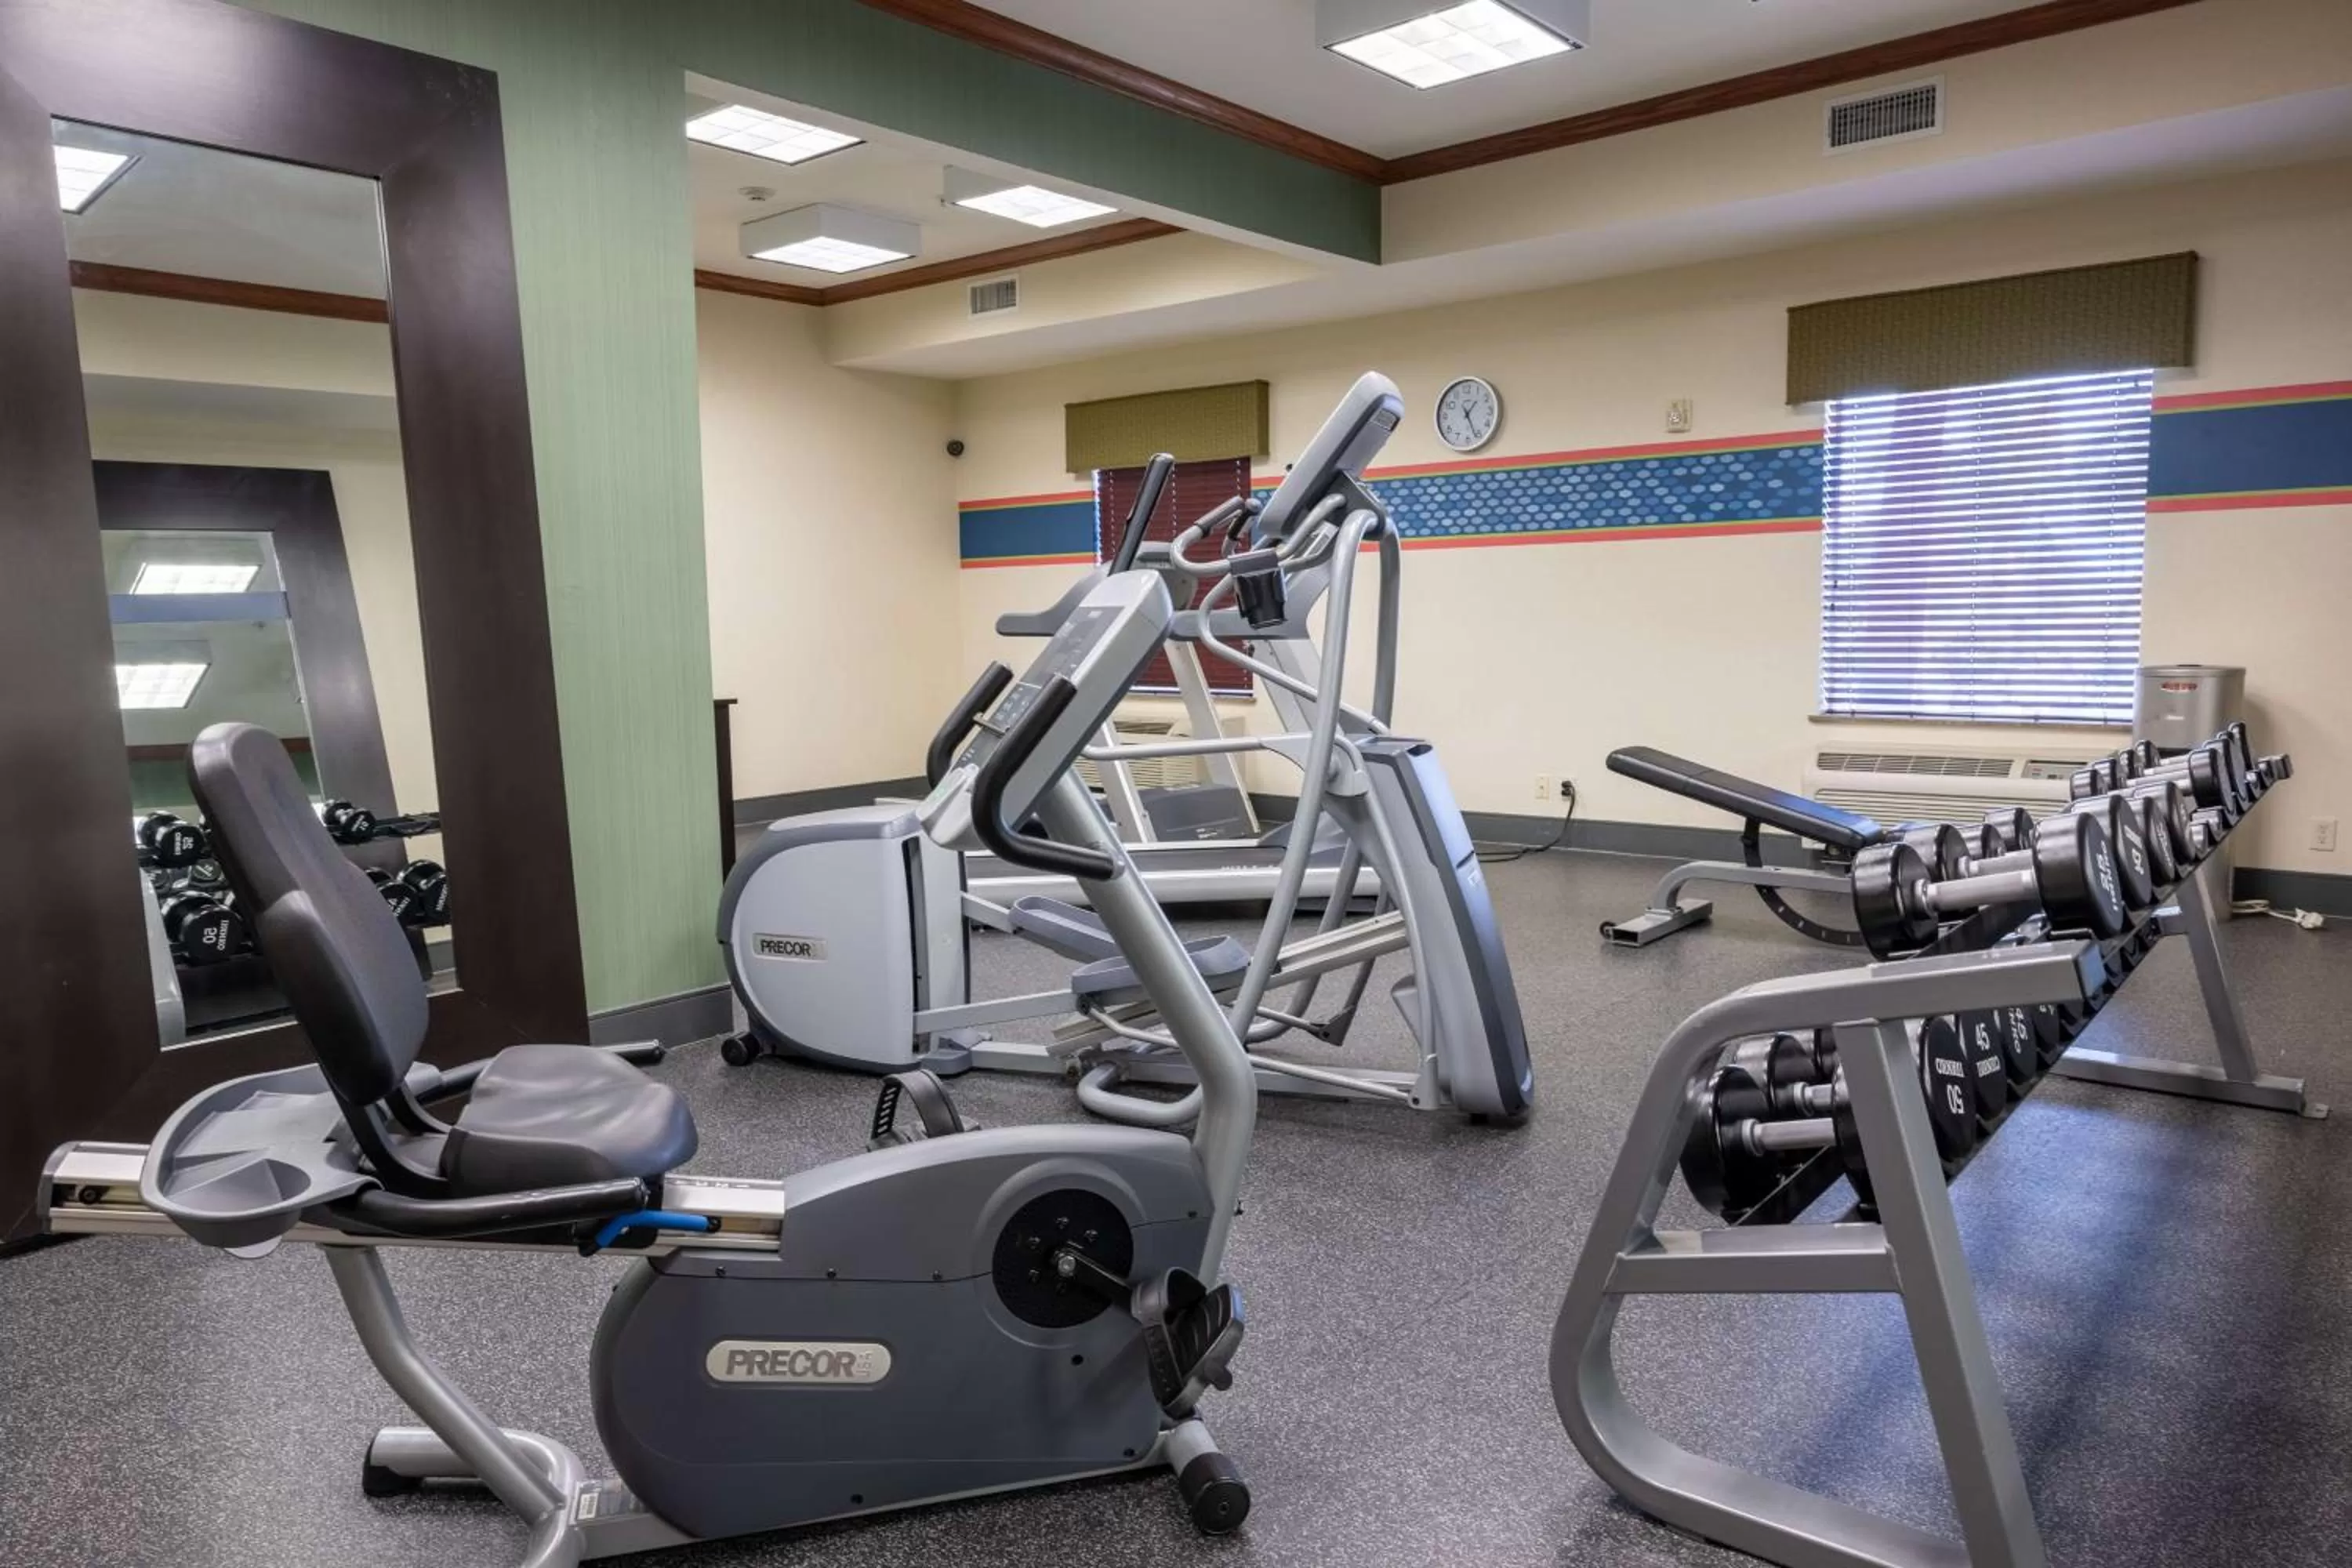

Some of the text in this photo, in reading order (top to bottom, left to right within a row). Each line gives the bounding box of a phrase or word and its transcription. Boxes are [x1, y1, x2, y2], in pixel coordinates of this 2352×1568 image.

[760, 939, 811, 957] PRECOR
[1975, 1022, 1991, 1051] 45
[1946, 1083, 1965, 1114] 50
[726, 1349, 857, 1377] PRECOR
